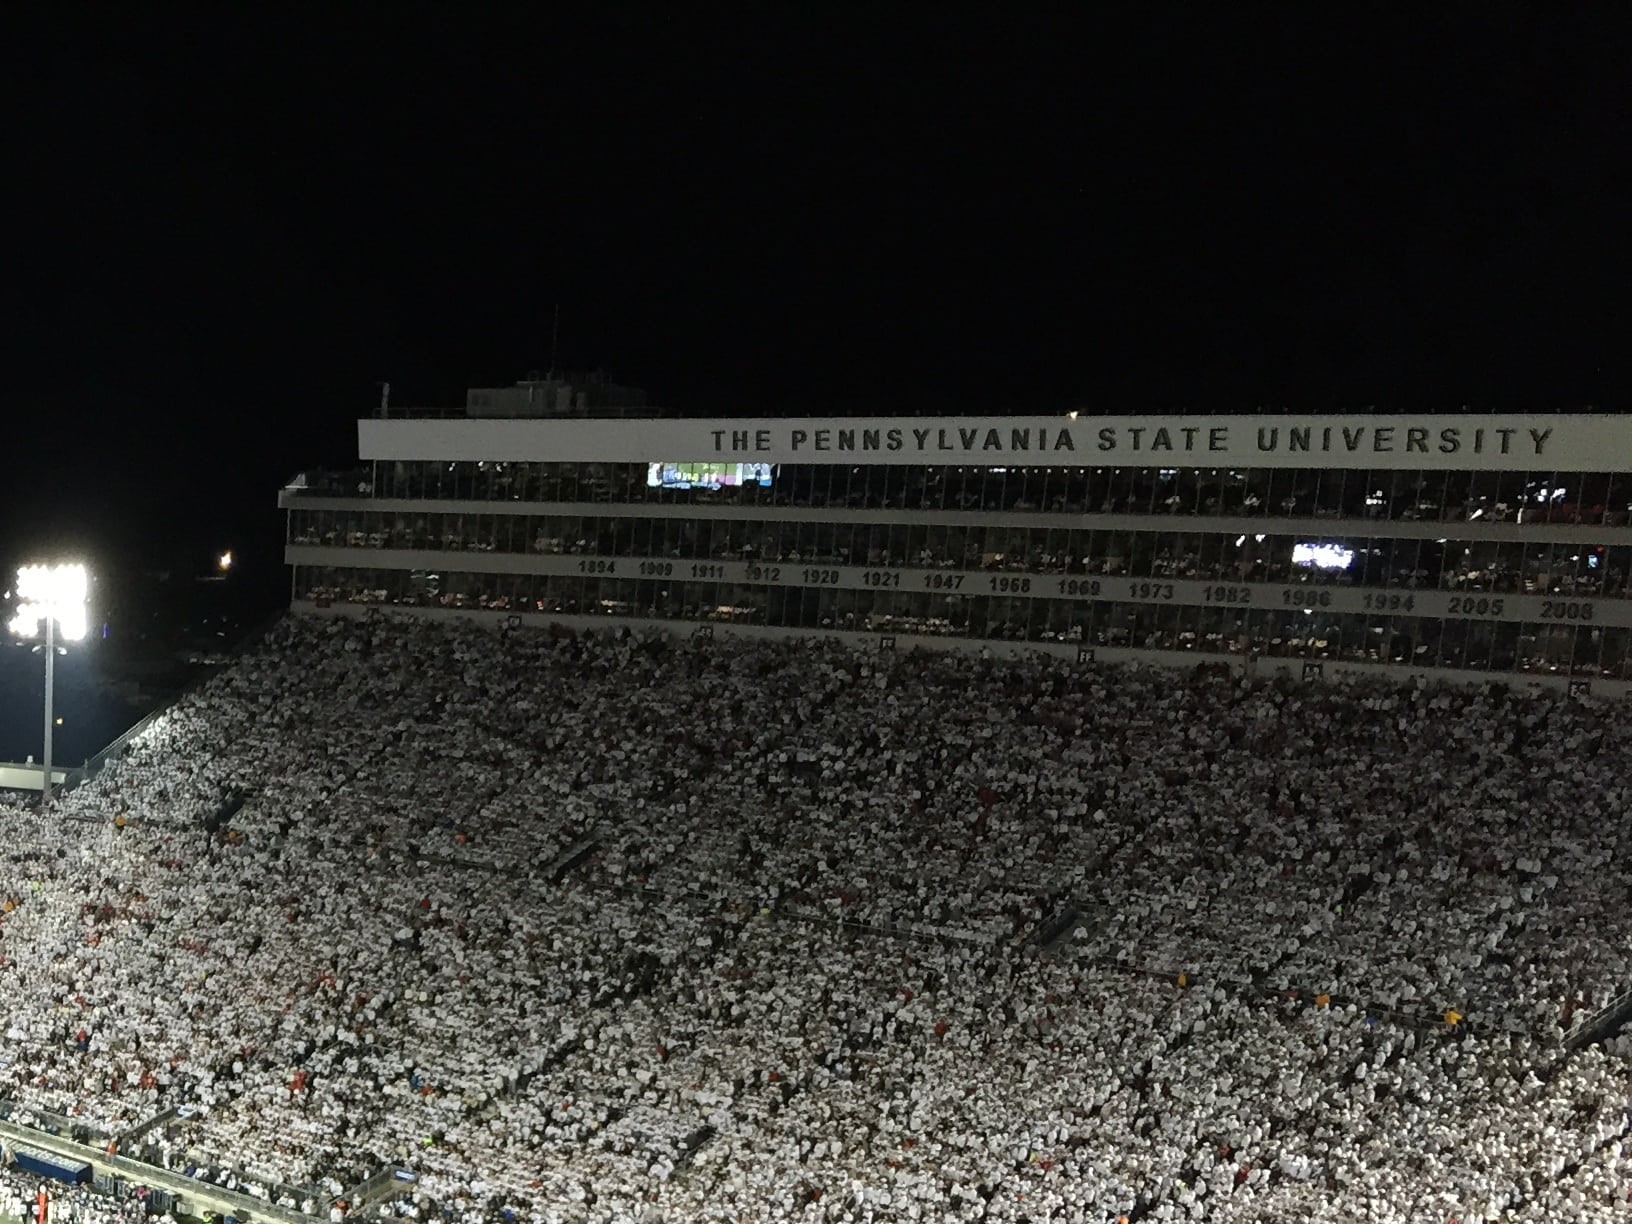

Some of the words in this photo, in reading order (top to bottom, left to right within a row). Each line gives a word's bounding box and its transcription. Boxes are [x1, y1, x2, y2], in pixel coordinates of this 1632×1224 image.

[712, 429, 771, 452] THE
[791, 427, 1075, 453] PENNSYLVANIA
[1097, 427, 1230, 452] STATE
[1256, 427, 1554, 455] UNIVERSITY
[690, 563, 725, 579] 1911
[746, 563, 782, 582] 1912
[802, 568, 841, 585] 1920
[863, 570, 901, 587] 1921
[924, 574, 966, 589] 1947
[989, 576, 1032, 594] 1968
[1058, 578, 1101, 596] 1969
[1129, 582, 1174, 599] 1973
[1203, 585, 1251, 603] 1982
[1448, 597, 1504, 616] 2005
